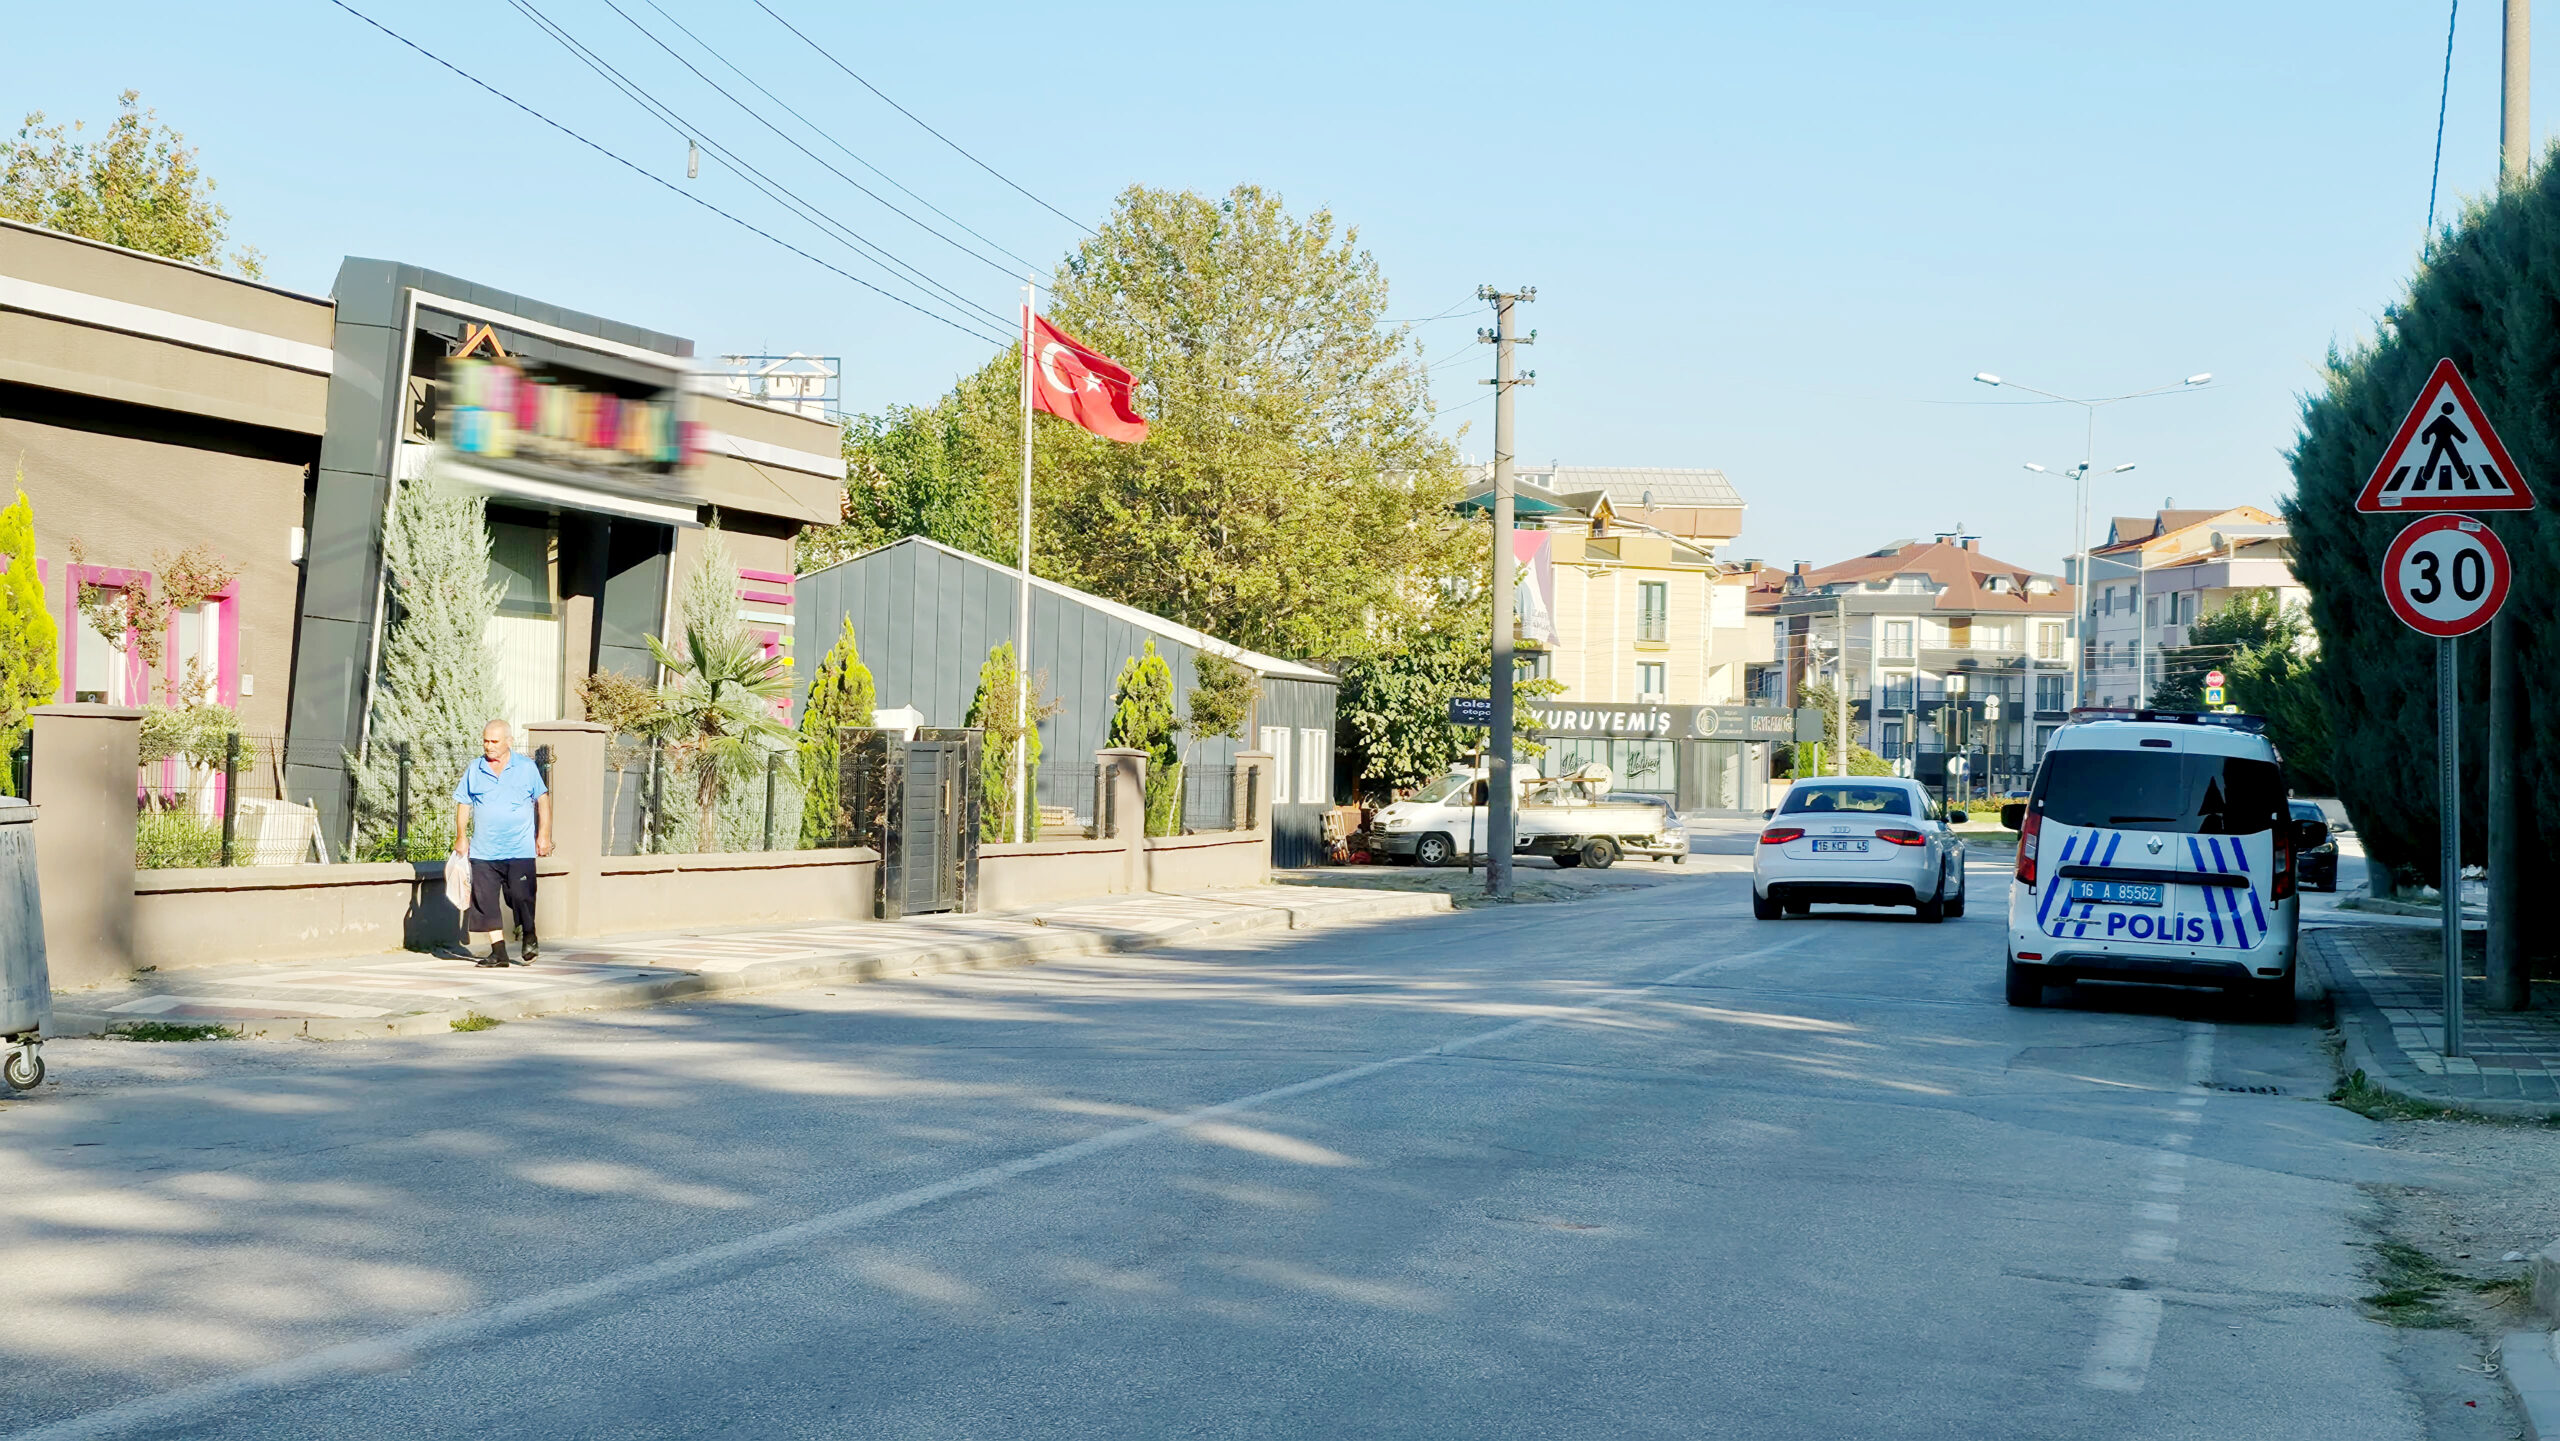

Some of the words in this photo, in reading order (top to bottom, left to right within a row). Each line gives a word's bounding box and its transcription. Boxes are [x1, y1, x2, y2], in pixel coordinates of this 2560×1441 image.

[2410, 548, 2485, 604] 30
[1455, 698, 1491, 708] Lalez
[1530, 706, 1672, 735] KURUYEMİŞ
[2081, 883, 2094, 897] 16
[2104, 884, 2111, 898] A
[2119, 885, 2157, 901] 85562
[2107, 912, 2205, 943] POLİS
